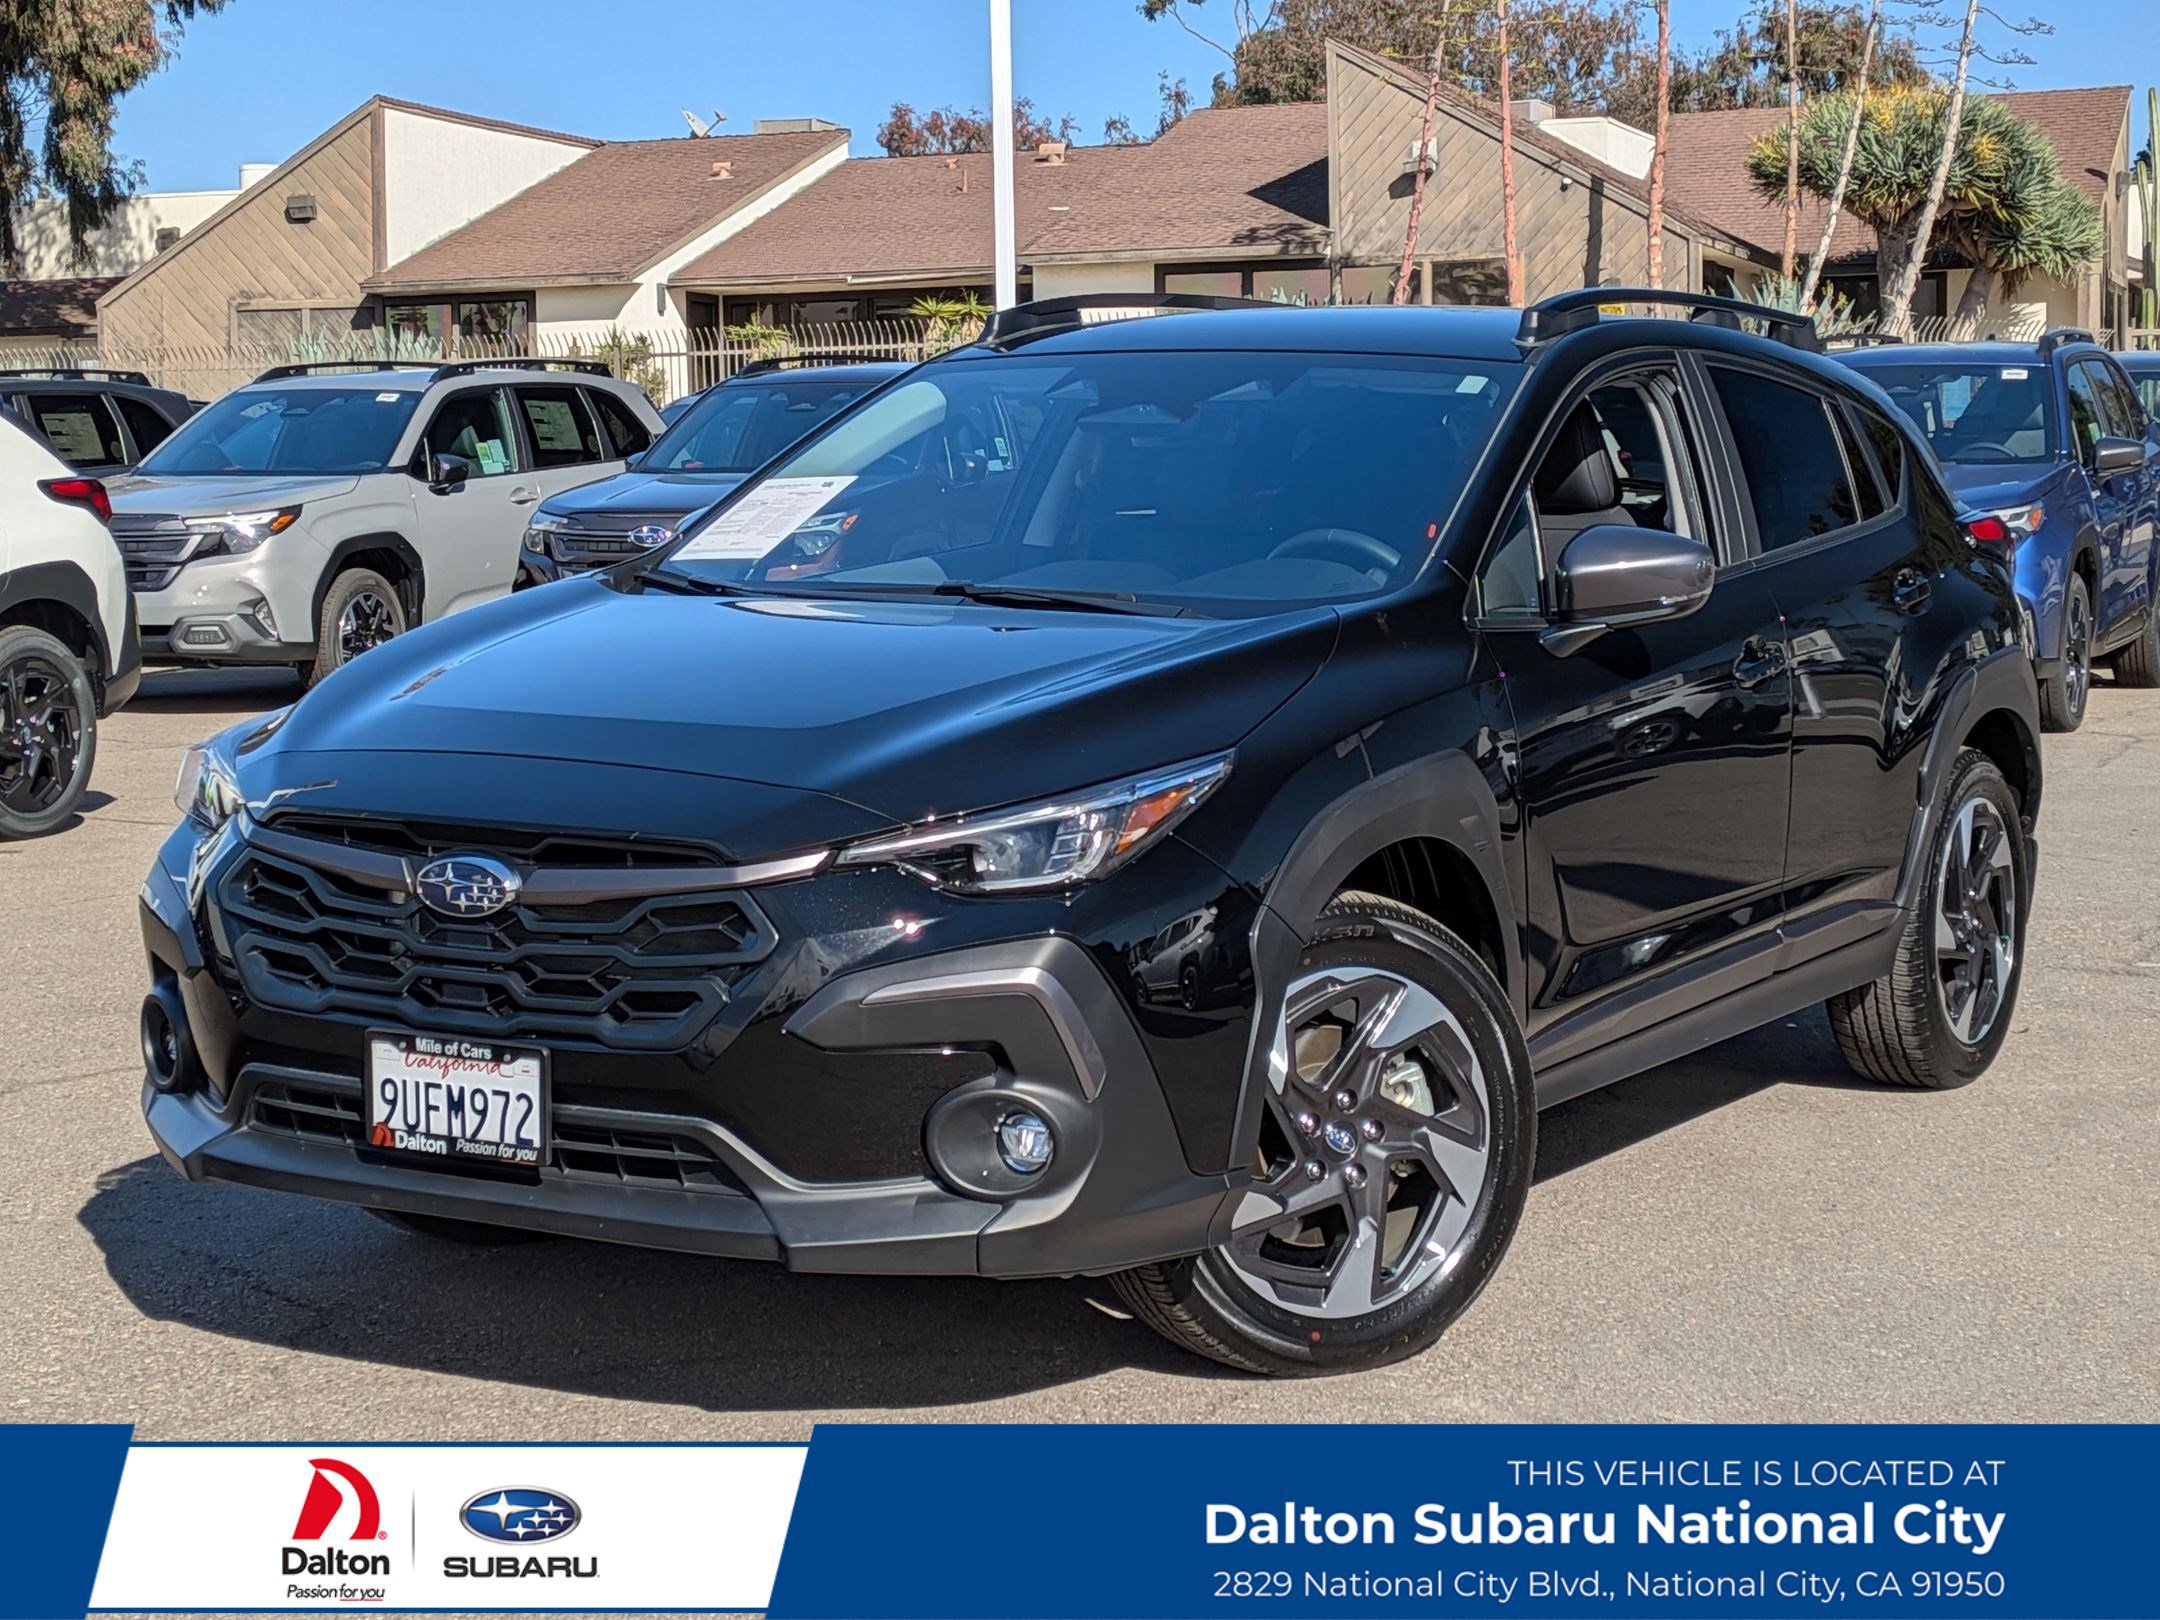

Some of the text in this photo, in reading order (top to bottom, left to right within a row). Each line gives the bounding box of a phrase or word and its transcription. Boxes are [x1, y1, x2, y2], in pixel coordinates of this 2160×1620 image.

[415, 1037, 492, 1060] Mile of Cars
[380, 1077, 534, 1147] 9UFM972
[395, 1130, 538, 1161] Dalton Passion for you
